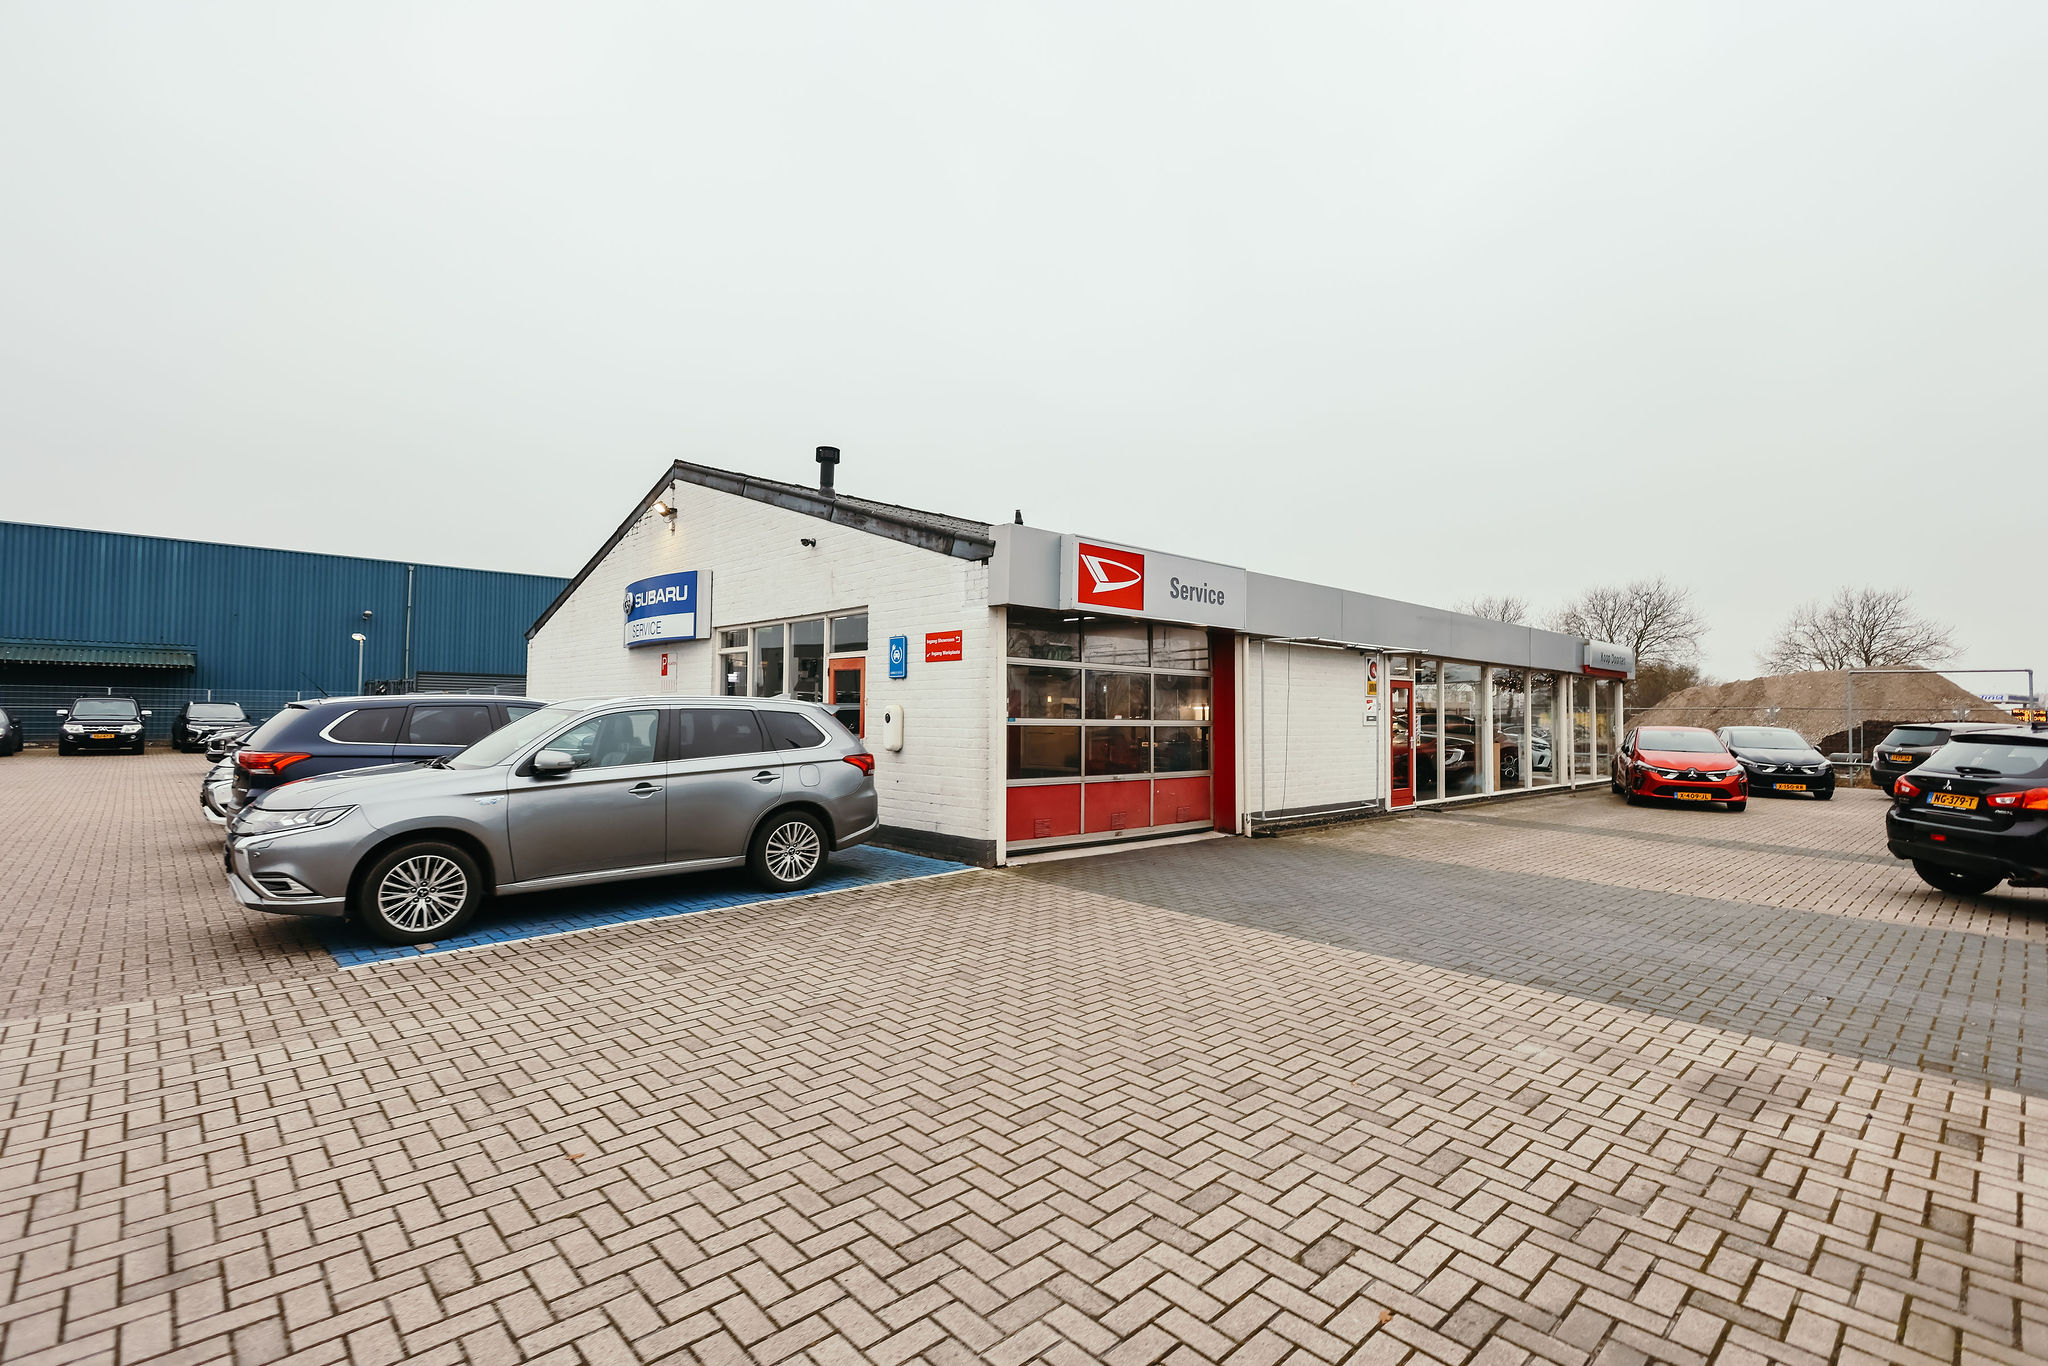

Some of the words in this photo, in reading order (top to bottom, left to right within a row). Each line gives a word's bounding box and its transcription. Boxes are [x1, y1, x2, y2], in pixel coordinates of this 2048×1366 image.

[635, 585, 688, 608] SUBARU
[1170, 577, 1225, 606] Service
[632, 621, 662, 638] SERVICE
[1933, 792, 1975, 807] NG-379-T
